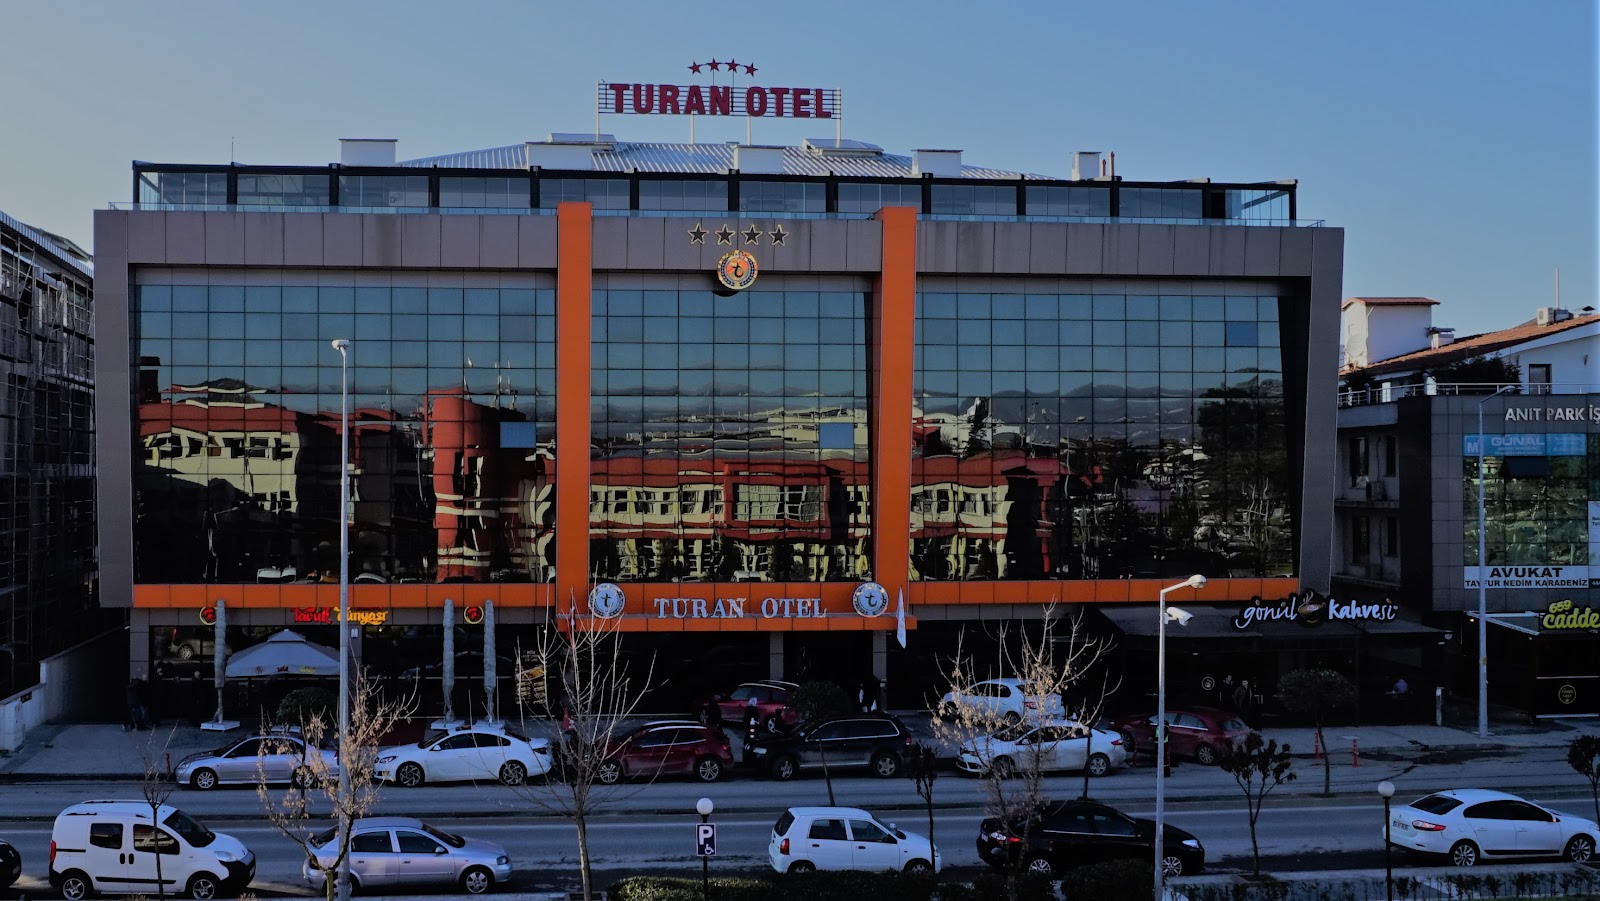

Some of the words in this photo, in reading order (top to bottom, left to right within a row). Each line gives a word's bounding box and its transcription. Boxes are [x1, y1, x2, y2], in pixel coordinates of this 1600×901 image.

[609, 83, 731, 115] TURAN
[745, 86, 832, 118] OTEL
[1504, 407, 1541, 421] ANIT
[1546, 407, 1585, 421] PARK
[1491, 434, 1545, 446] GÜNAL
[1490, 567, 1563, 578] AVUKAT
[1503, 579, 1532, 587] NEDİM
[1535, 578, 1588, 587] KARADENİZ
[653, 597, 747, 619] TURAN
[760, 597, 827, 619] OTEL
[1549, 599, 1572, 613] 659
[699, 826, 713, 845] P
